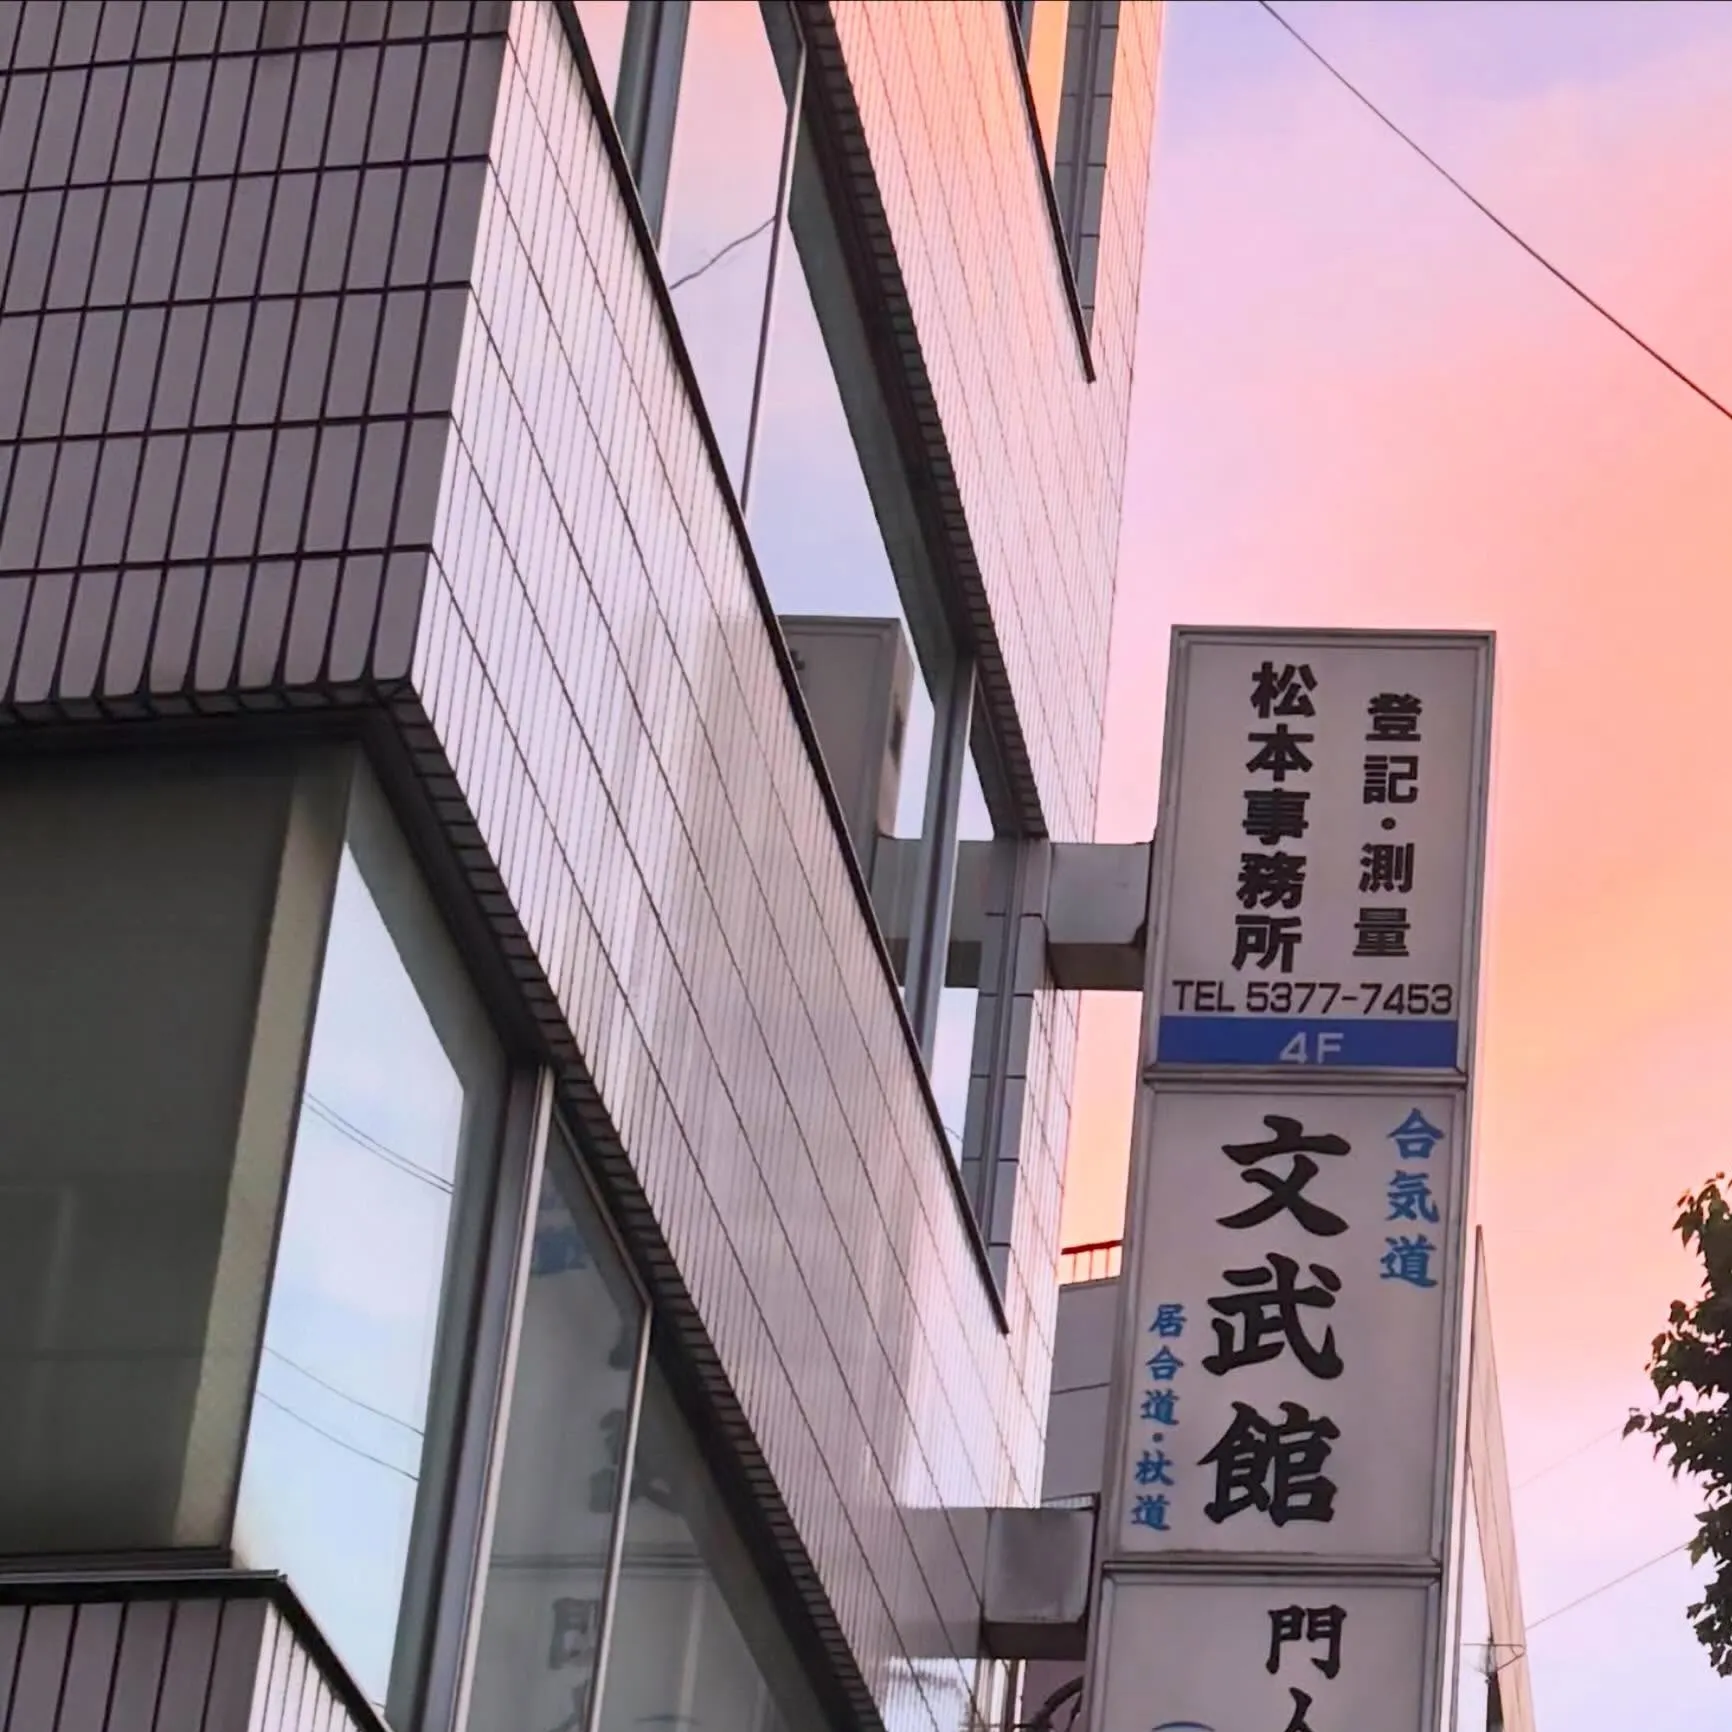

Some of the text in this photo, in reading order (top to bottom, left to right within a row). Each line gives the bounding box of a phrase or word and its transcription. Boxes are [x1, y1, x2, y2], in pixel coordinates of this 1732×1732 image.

[1231, 661, 1318, 973] 松本事務所
[1352, 693, 1422, 957] 登記・測量
[1172, 980, 1454, 1016] TEL 5377-7453
[1379, 1107, 1445, 1288] 合気道
[1130, 1303, 1188, 1532] 居合道・杖道
[1196, 1114, 1352, 1528] 文武館
